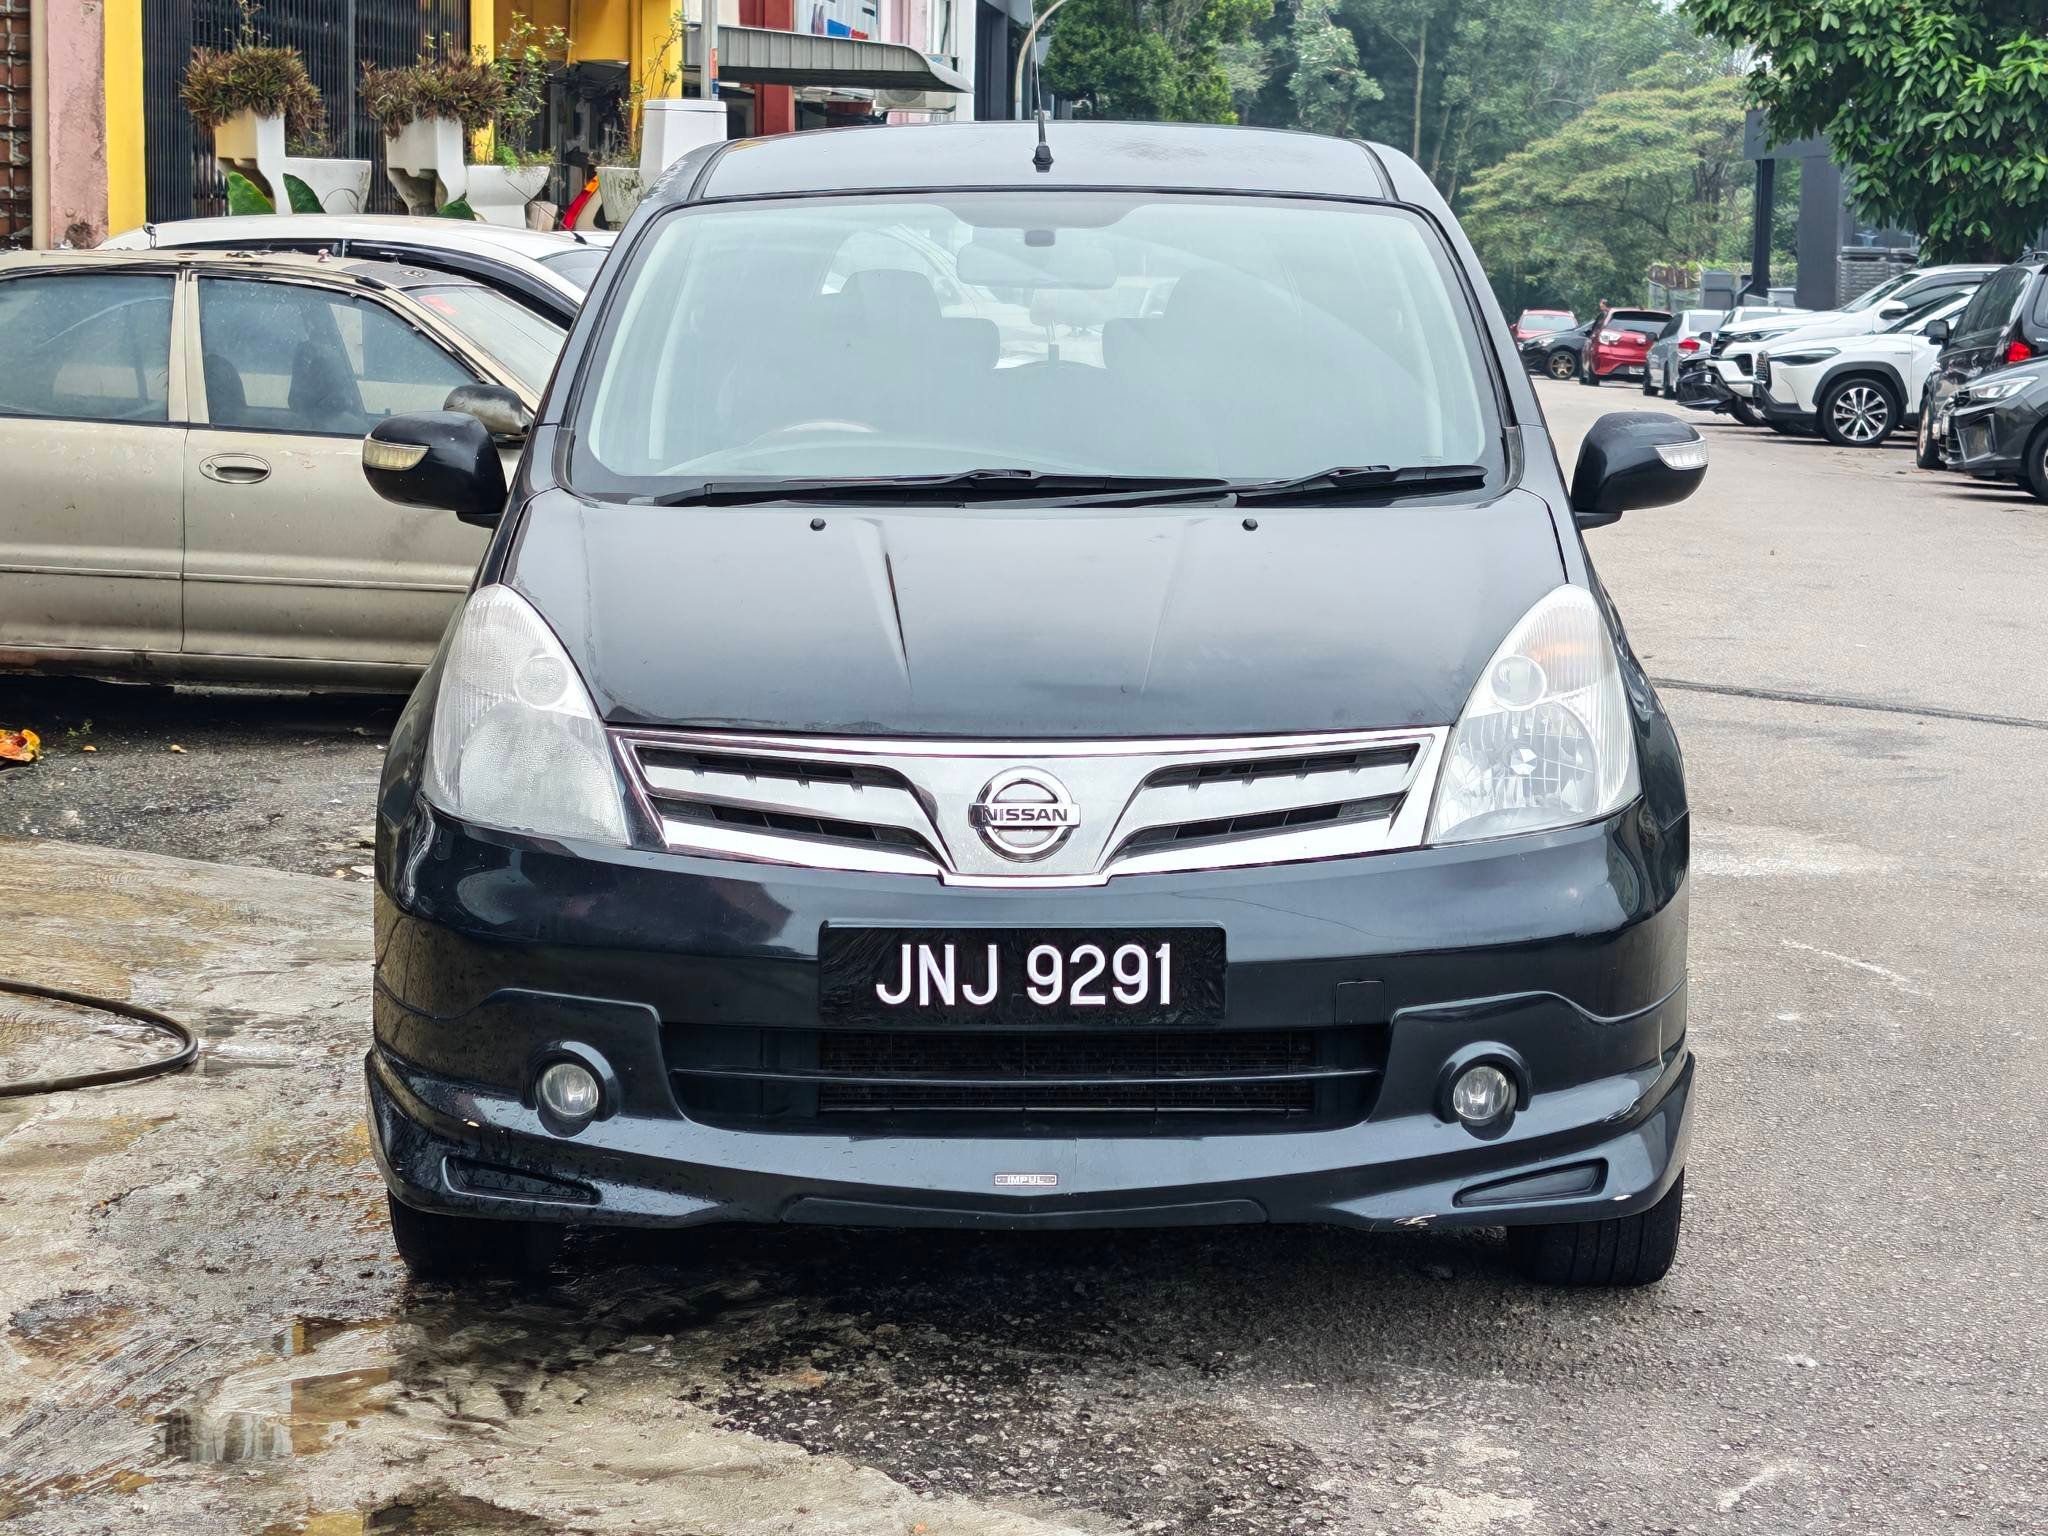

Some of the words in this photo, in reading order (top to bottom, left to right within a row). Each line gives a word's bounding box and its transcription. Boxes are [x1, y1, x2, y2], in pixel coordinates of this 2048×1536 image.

[983, 807, 1067, 822] NISSAN
[876, 943, 997, 1006] JNJ
[1026, 943, 1171, 1006] 9291
